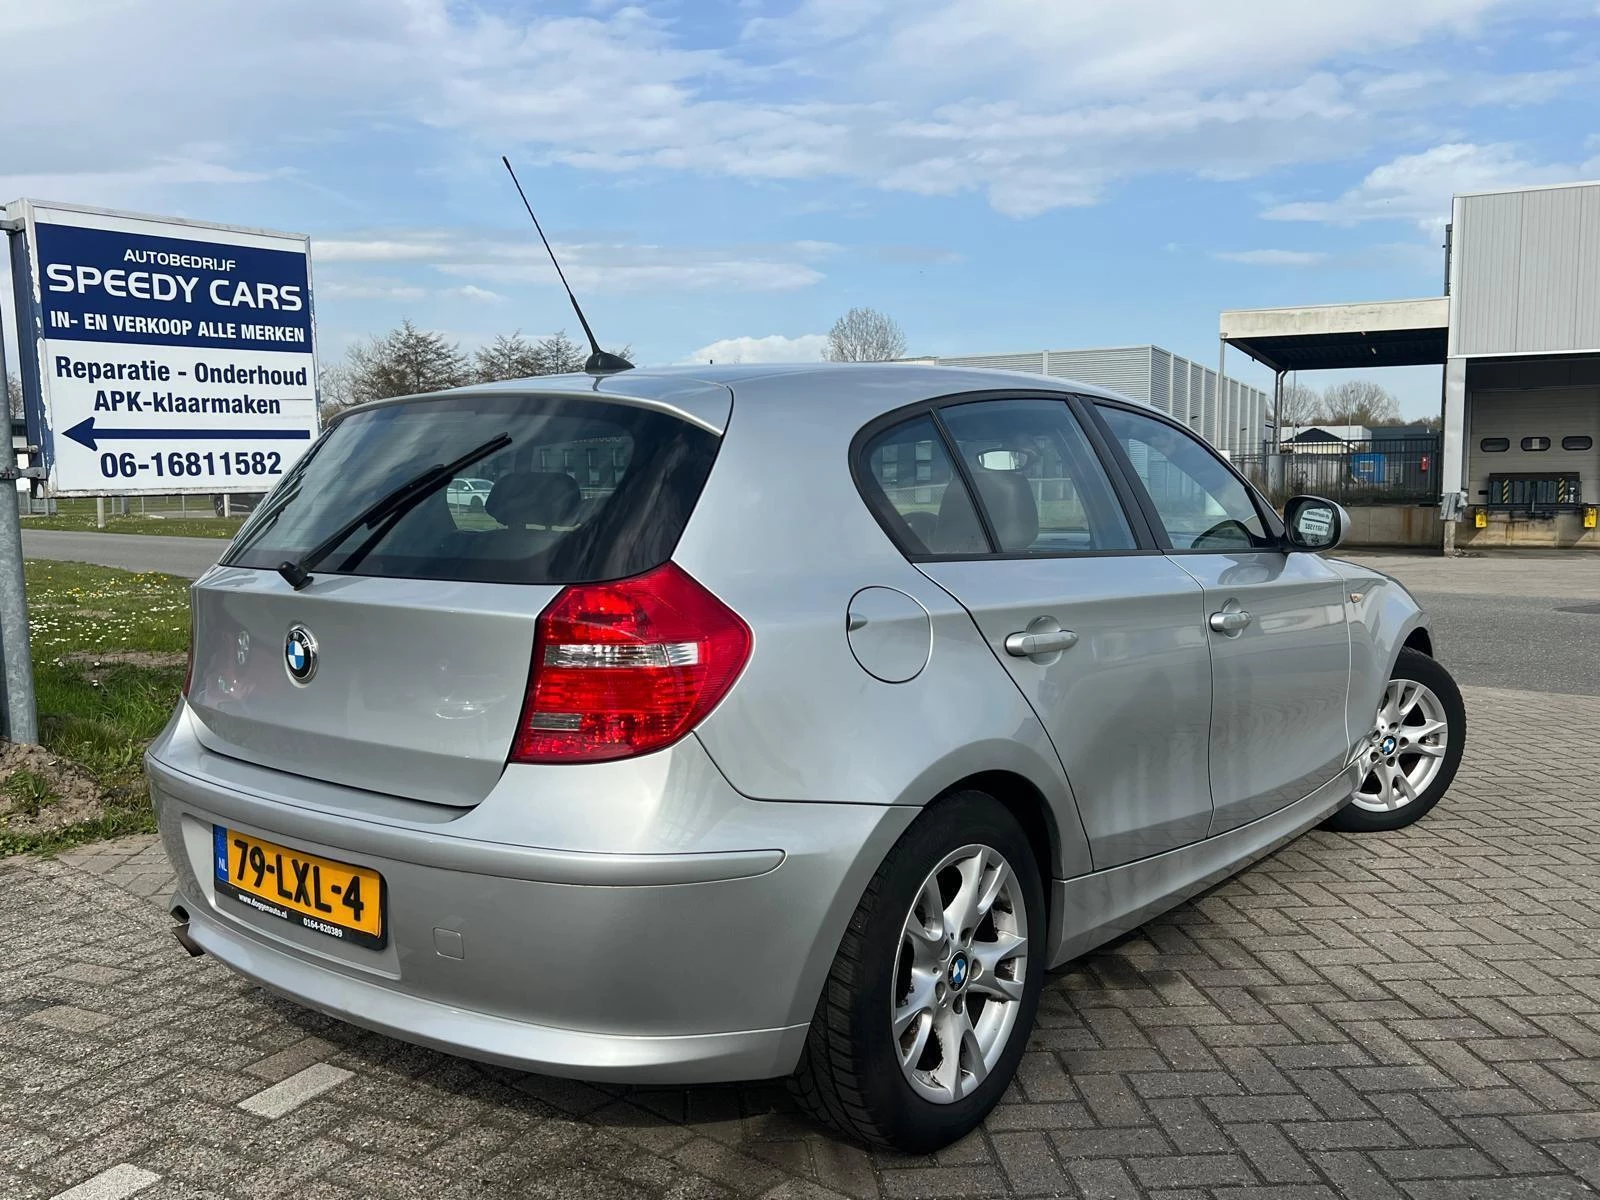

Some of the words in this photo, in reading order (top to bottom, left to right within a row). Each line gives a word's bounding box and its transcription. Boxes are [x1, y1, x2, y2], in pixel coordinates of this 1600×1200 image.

[123, 248, 236, 272] AUTOBEDRIJF
[46, 263, 199, 303] SPEEDY
[209, 279, 303, 312] CARS
[50, 310, 78, 328] IN-
[84, 312, 108, 331] EN
[112, 314, 192, 336] VERKOOP
[198, 320, 236, 339] ALLE
[241, 323, 305, 343] MERKEN
[55, 355, 170, 384] Reparatie
[194, 362, 307, 386] Onderhoud
[94, 390, 281, 415] APK-klaarmaken
[100, 451, 282, 478] 06-16811582
[218, 857, 228, 872] NL
[233, 838, 364, 922] 79-LXL-4
[303, 917, 343, 938] 0164-820389
